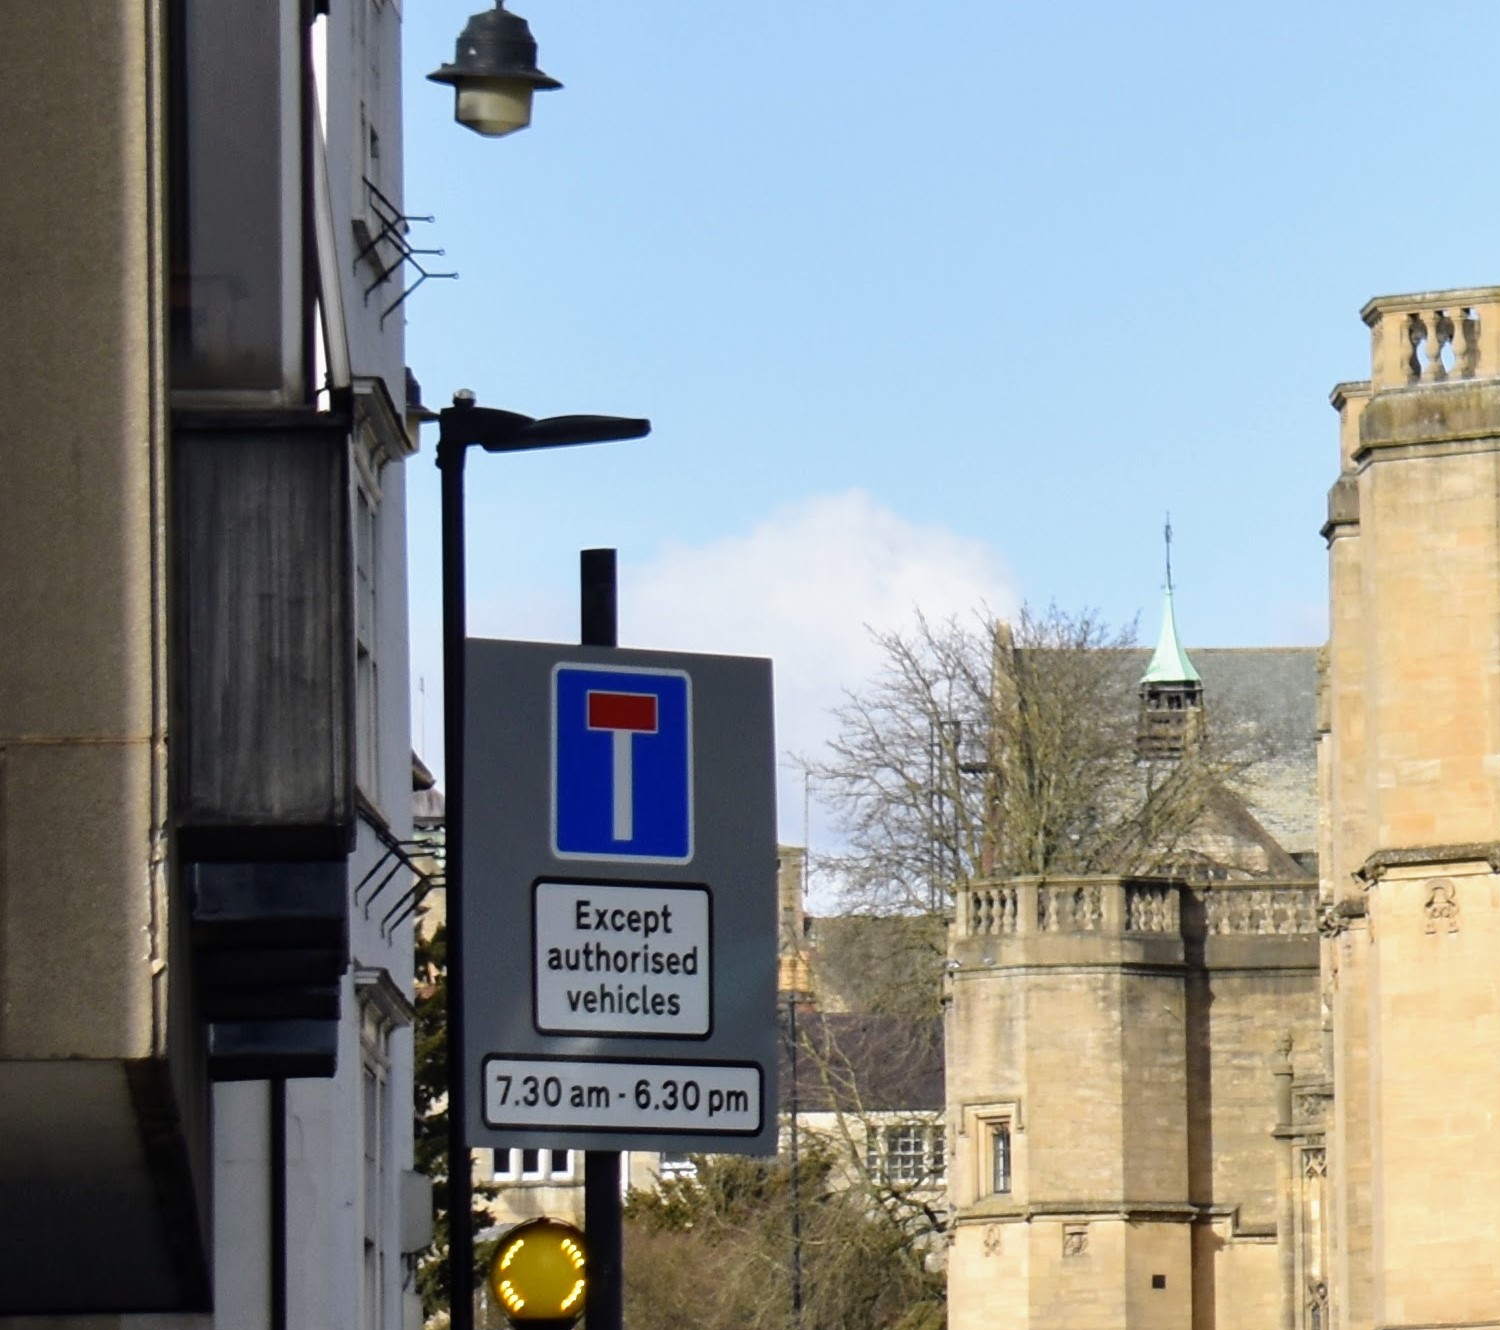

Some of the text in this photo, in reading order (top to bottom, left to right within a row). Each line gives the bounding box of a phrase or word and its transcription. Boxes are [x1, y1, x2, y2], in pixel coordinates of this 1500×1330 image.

[575, 899, 673, 938] Except
[547, 942, 698, 976] authorised
[566, 983, 681, 1017] vehicles
[496, 1074, 562, 1108] 7.30
[570, 1083, 611, 1109] am
[634, 1078, 700, 1112] 6.30
[708, 1087, 749, 1118] pm
